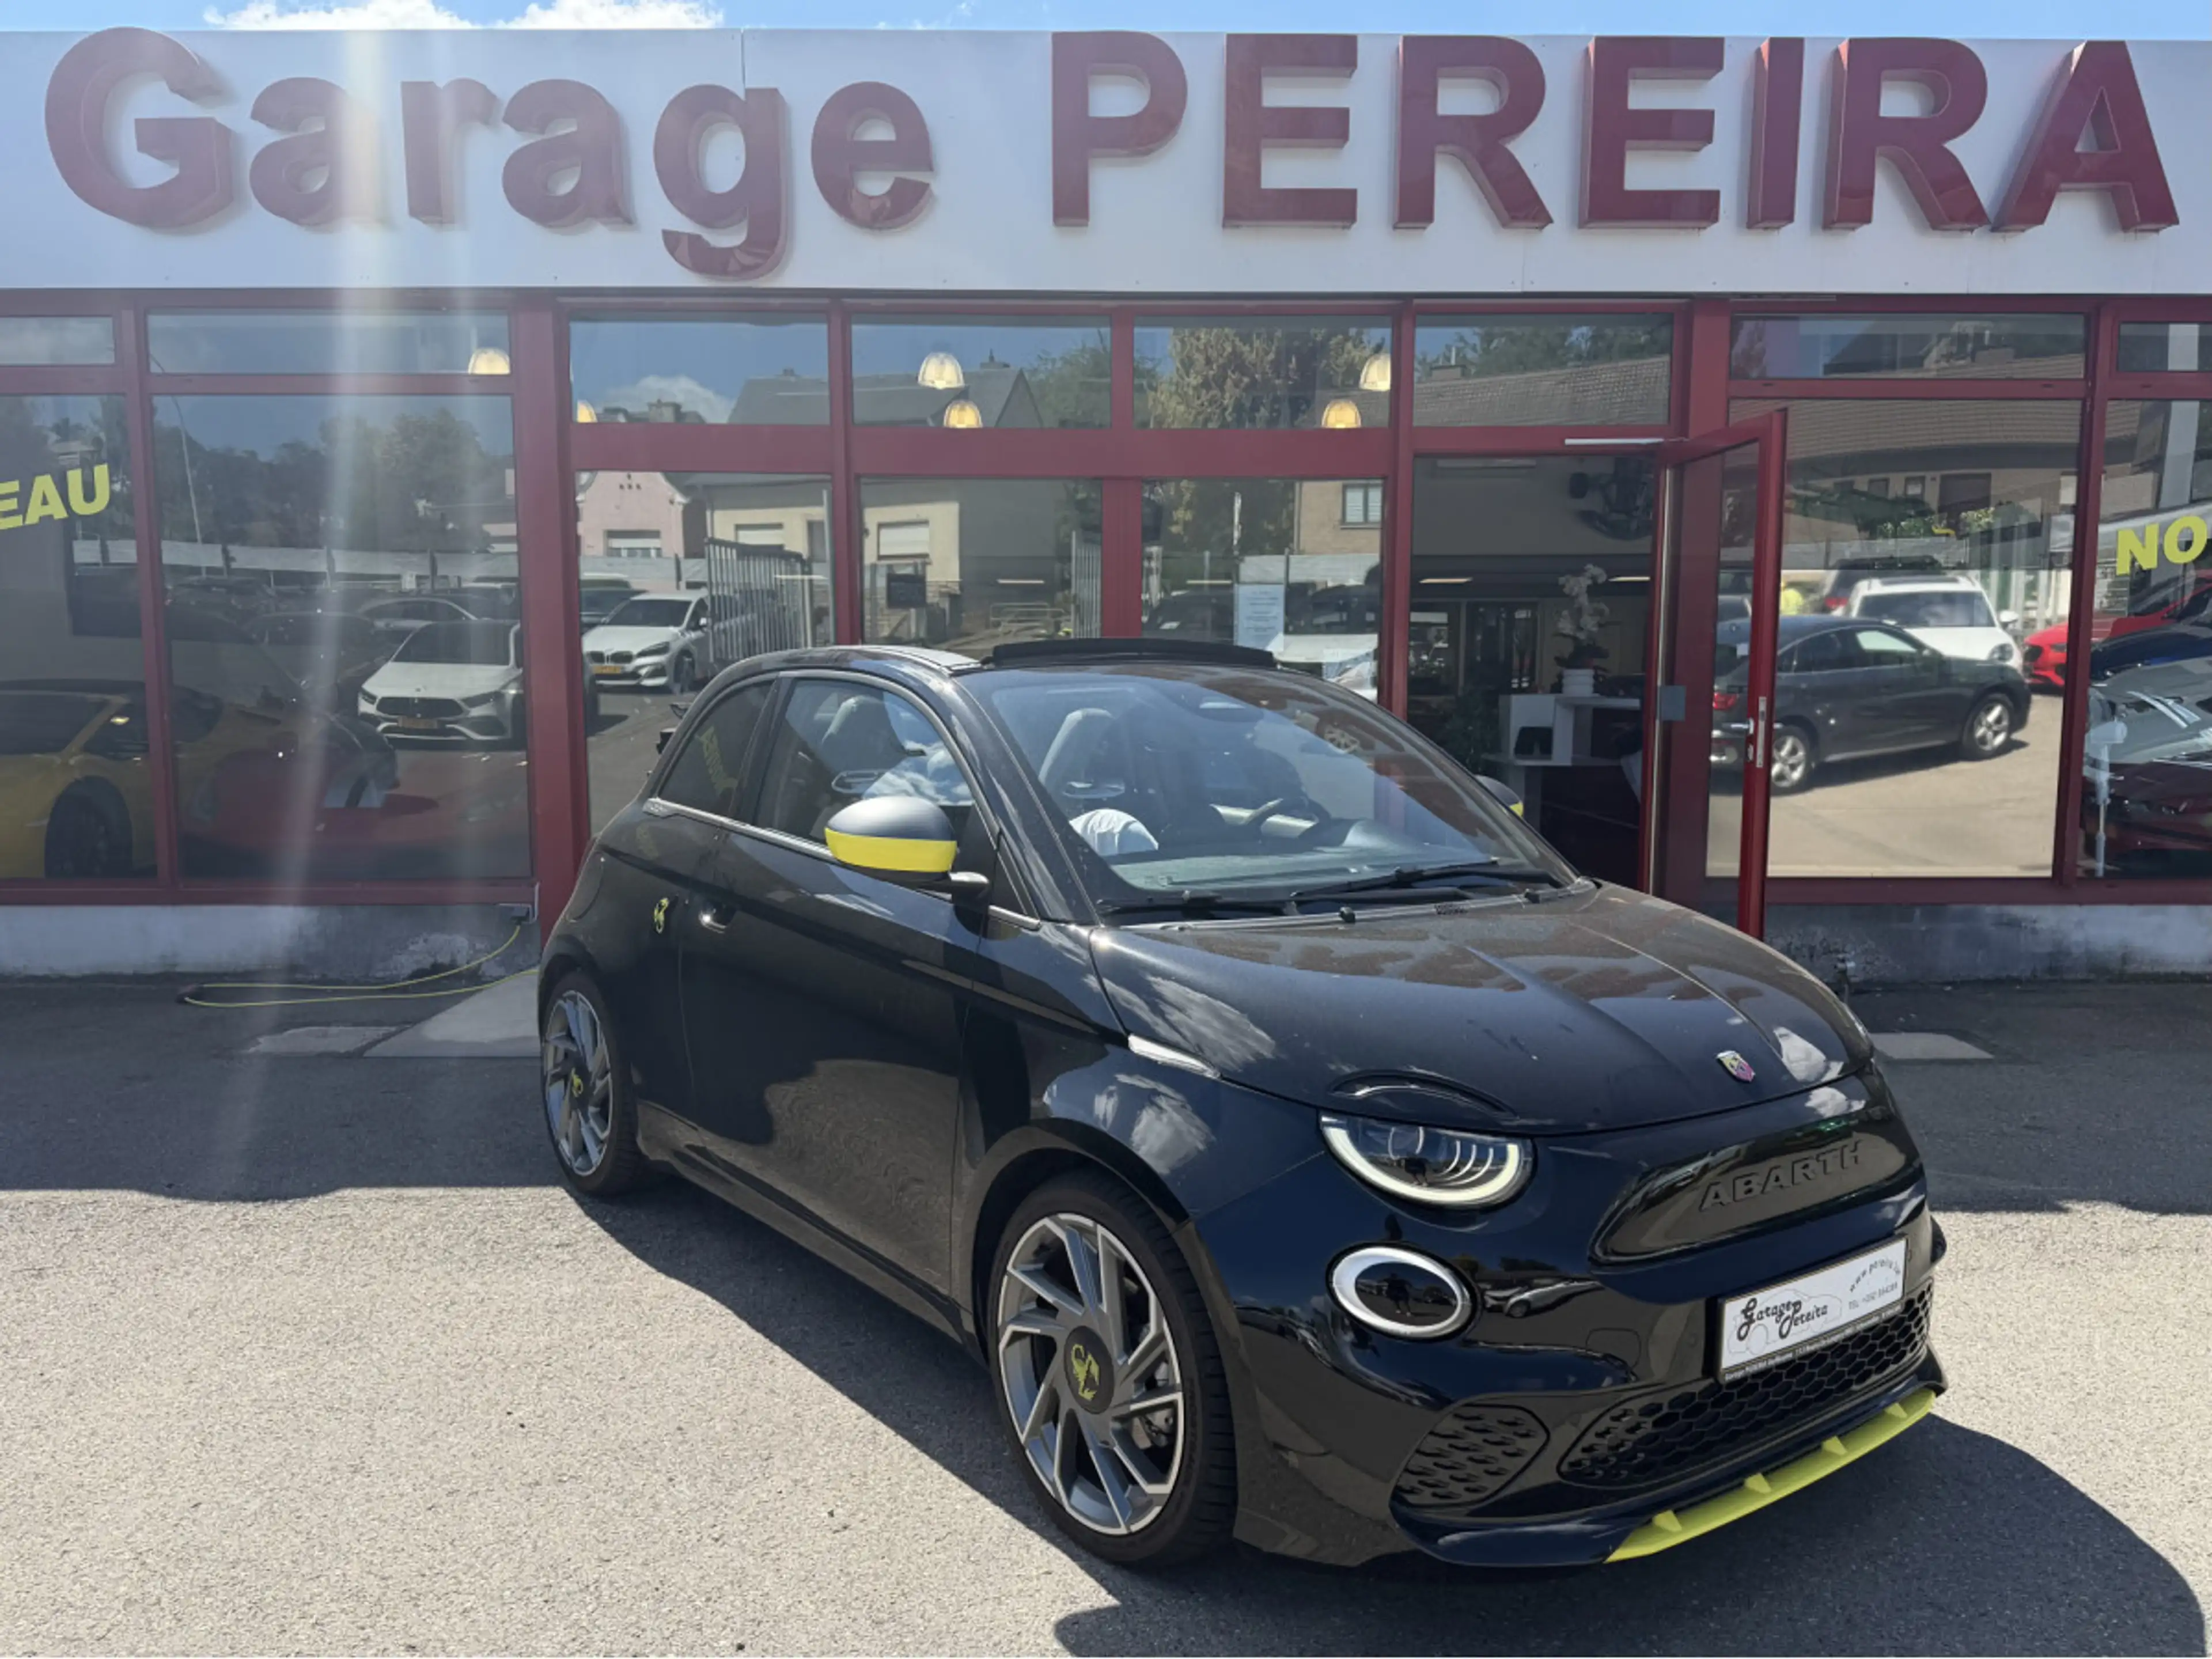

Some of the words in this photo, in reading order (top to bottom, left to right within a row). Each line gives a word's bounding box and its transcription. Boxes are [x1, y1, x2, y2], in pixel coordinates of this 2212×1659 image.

[45, 26, 934, 281] Garage
[1051, 31, 2180, 233] PEREIRA
[0, 463, 110, 529] EAU
[2116, 516, 2207, 576] NO
[1699, 1139, 1863, 1212] ABARTH
[1737, 1297, 1793, 1342] Garage
